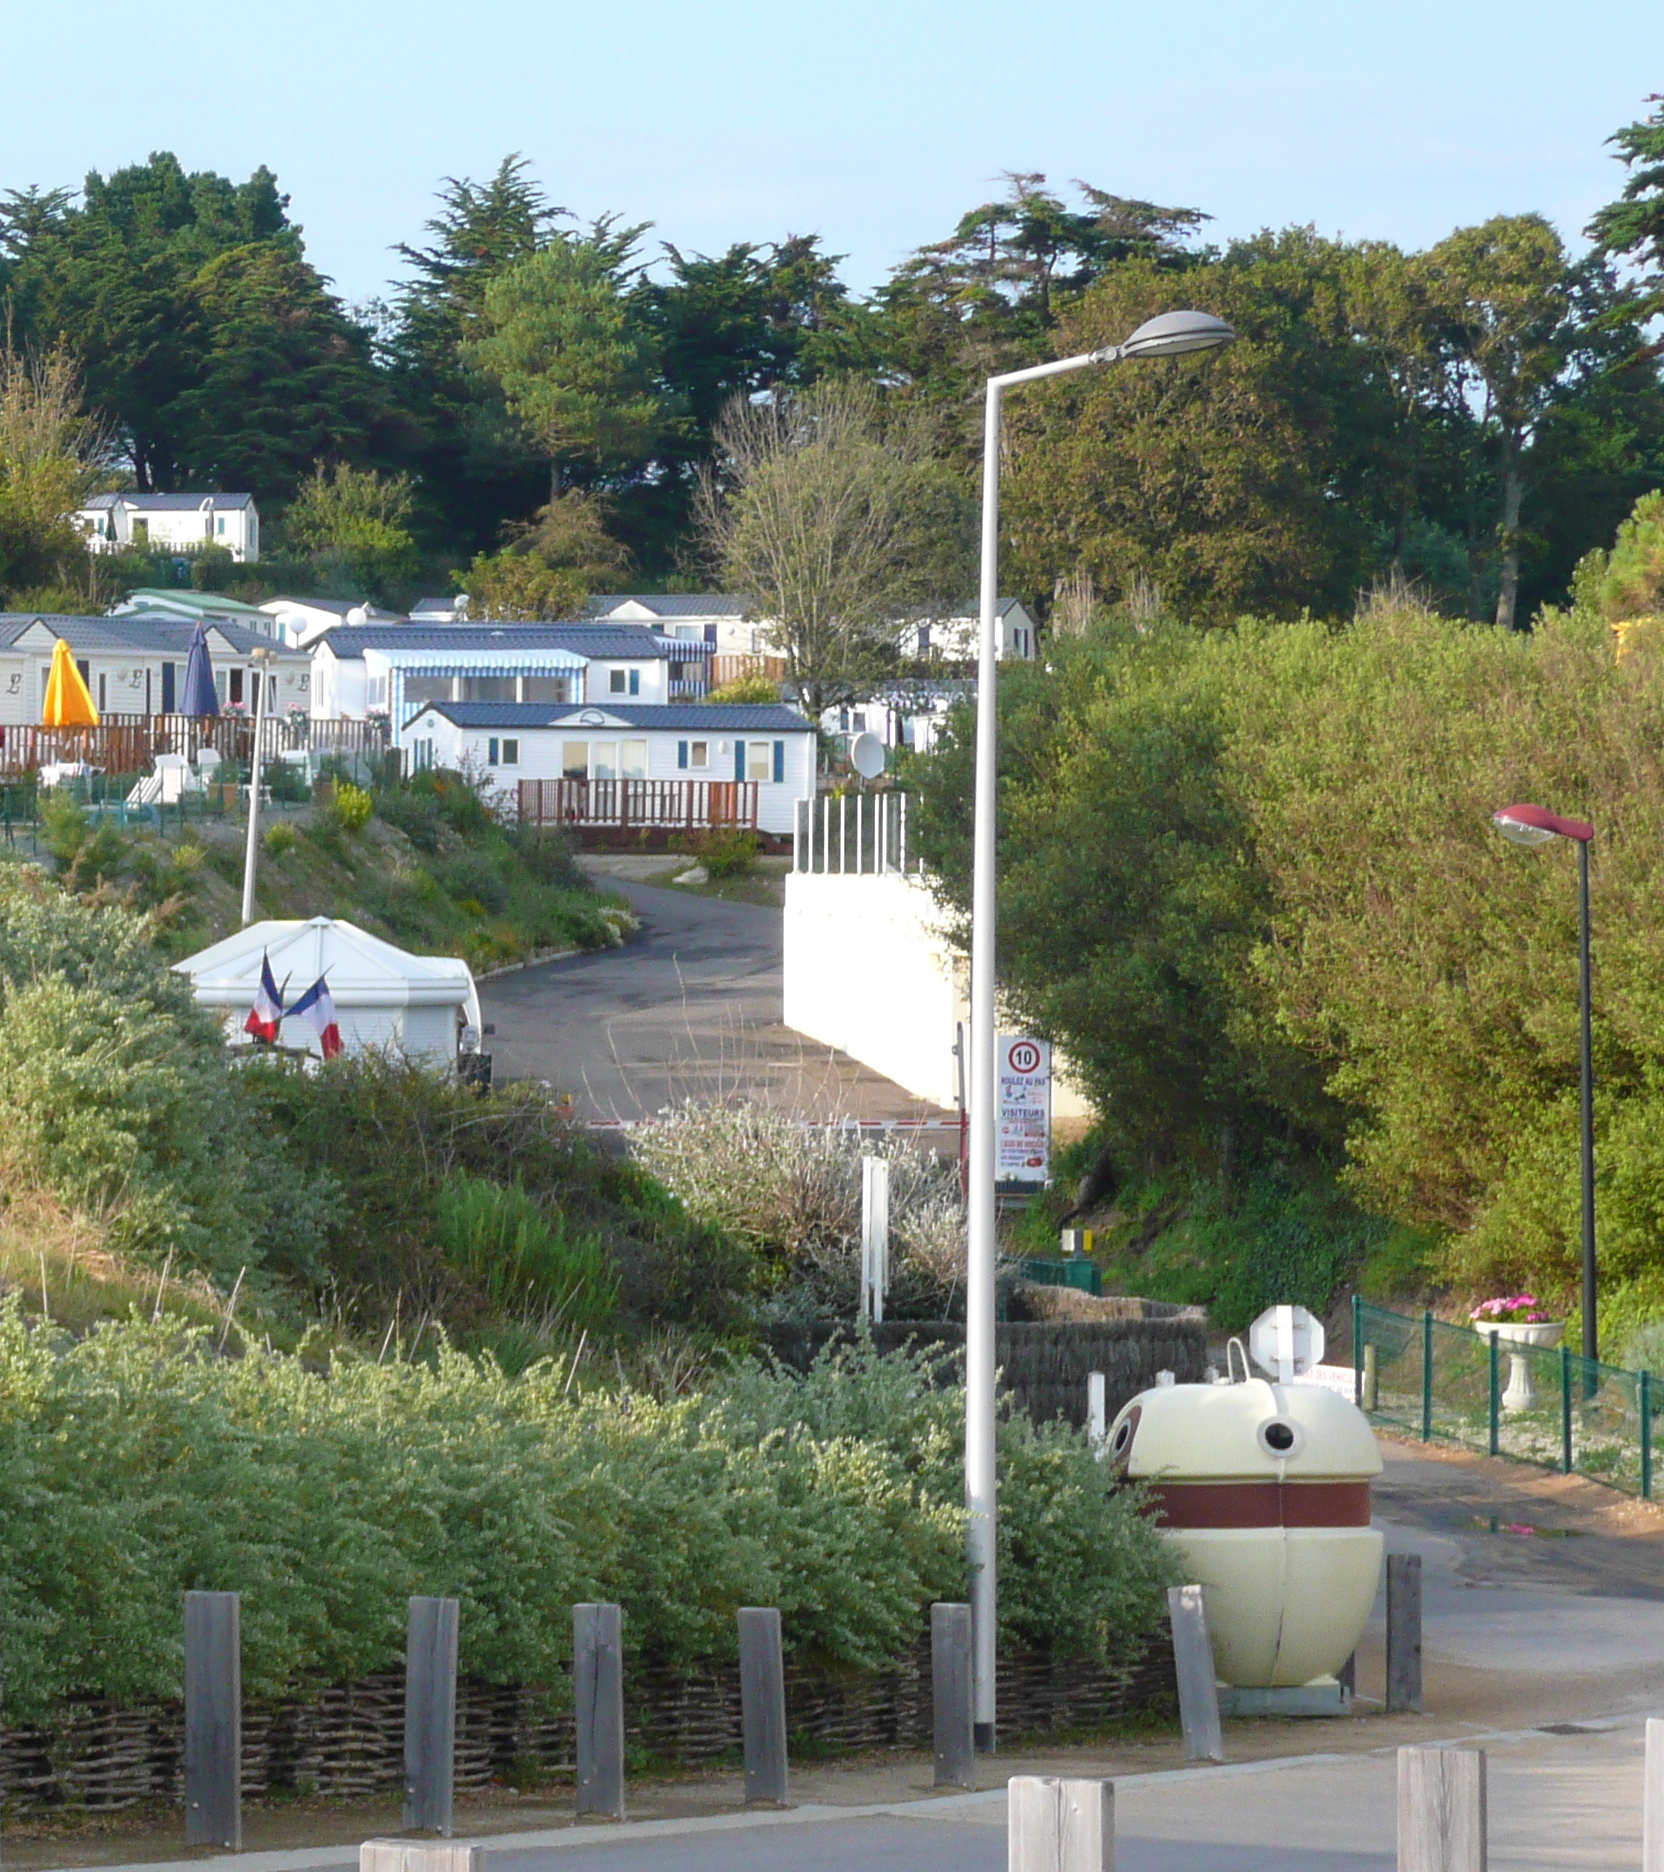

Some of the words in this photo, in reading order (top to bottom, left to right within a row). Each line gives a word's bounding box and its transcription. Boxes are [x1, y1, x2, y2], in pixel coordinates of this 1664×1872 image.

[1016, 1050, 1032, 1065] 10
[1001, 1077, 1024, 1086] ROULEZ
[1025, 1078, 1033, 1086] AU
[1034, 1078, 1045, 1086] PAS
[1001, 1109, 1045, 1118] VISITEURS
